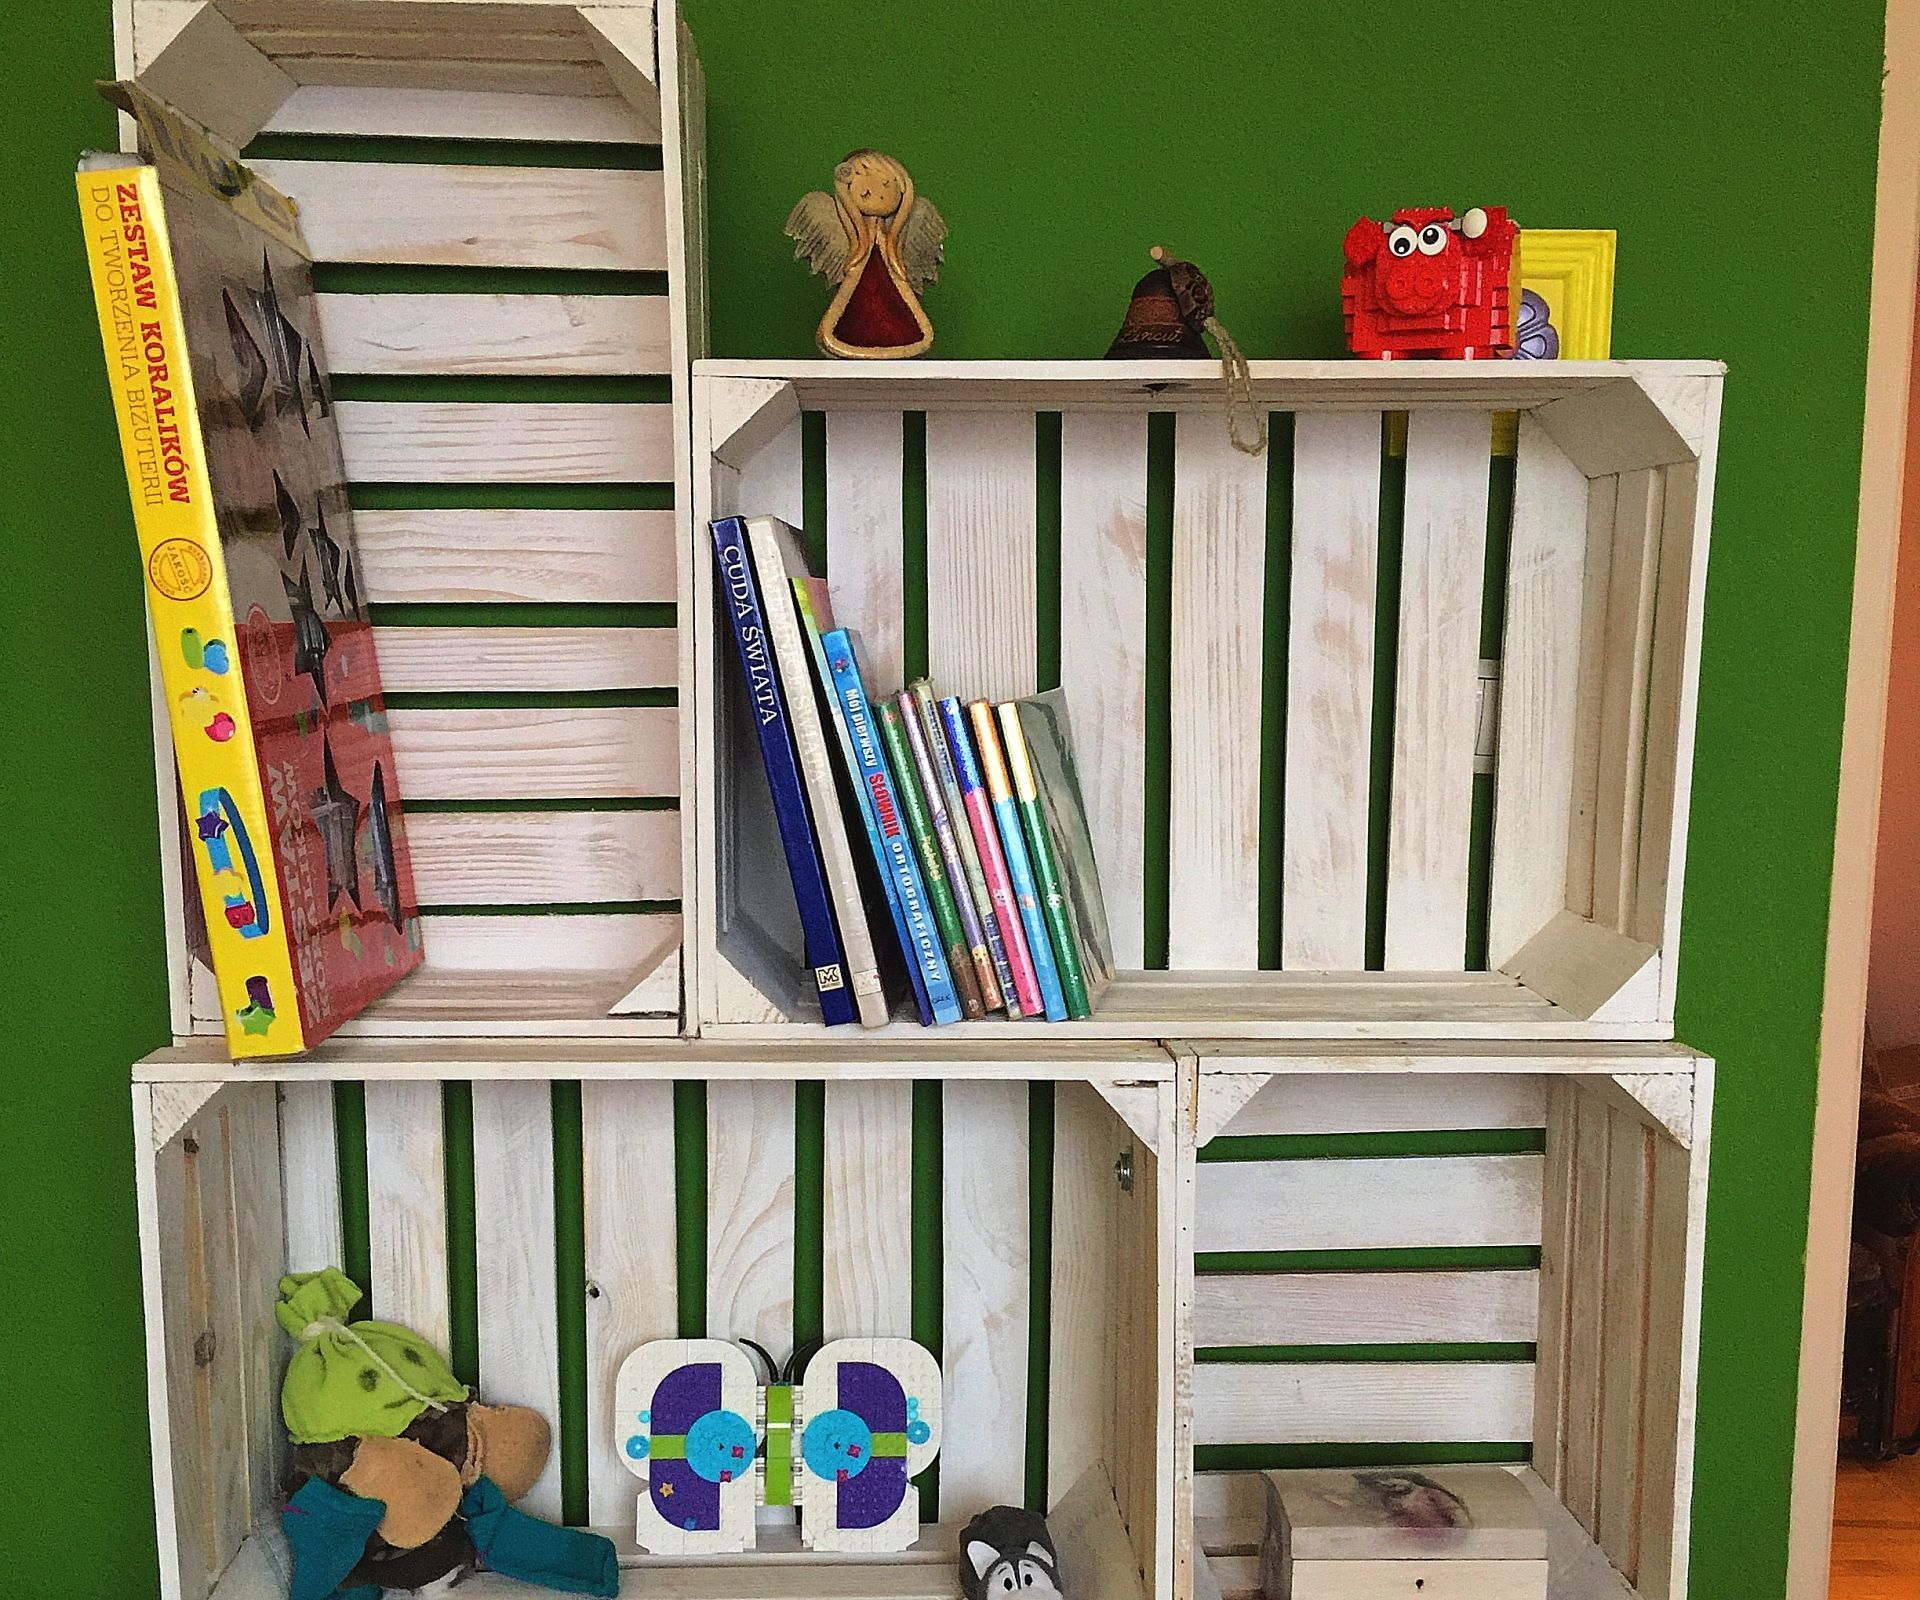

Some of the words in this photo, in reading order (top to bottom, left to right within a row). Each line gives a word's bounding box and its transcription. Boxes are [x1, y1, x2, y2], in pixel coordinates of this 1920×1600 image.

[91, 184, 114, 222] DO
[100, 229, 141, 381] TWORZENIA
[116, 183, 157, 309] ZESTAW
[140, 321, 190, 504] KORALIKÓW
[724, 545, 754, 620] CUDA
[742, 625, 778, 726] ŚWIATA
[267, 764, 320, 1029] ZESTAW
[851, 713, 878, 768] pierwszy
[868, 772, 901, 839] SŁOWNIK
[892, 842, 941, 982] ORTOGRAFICZNY
